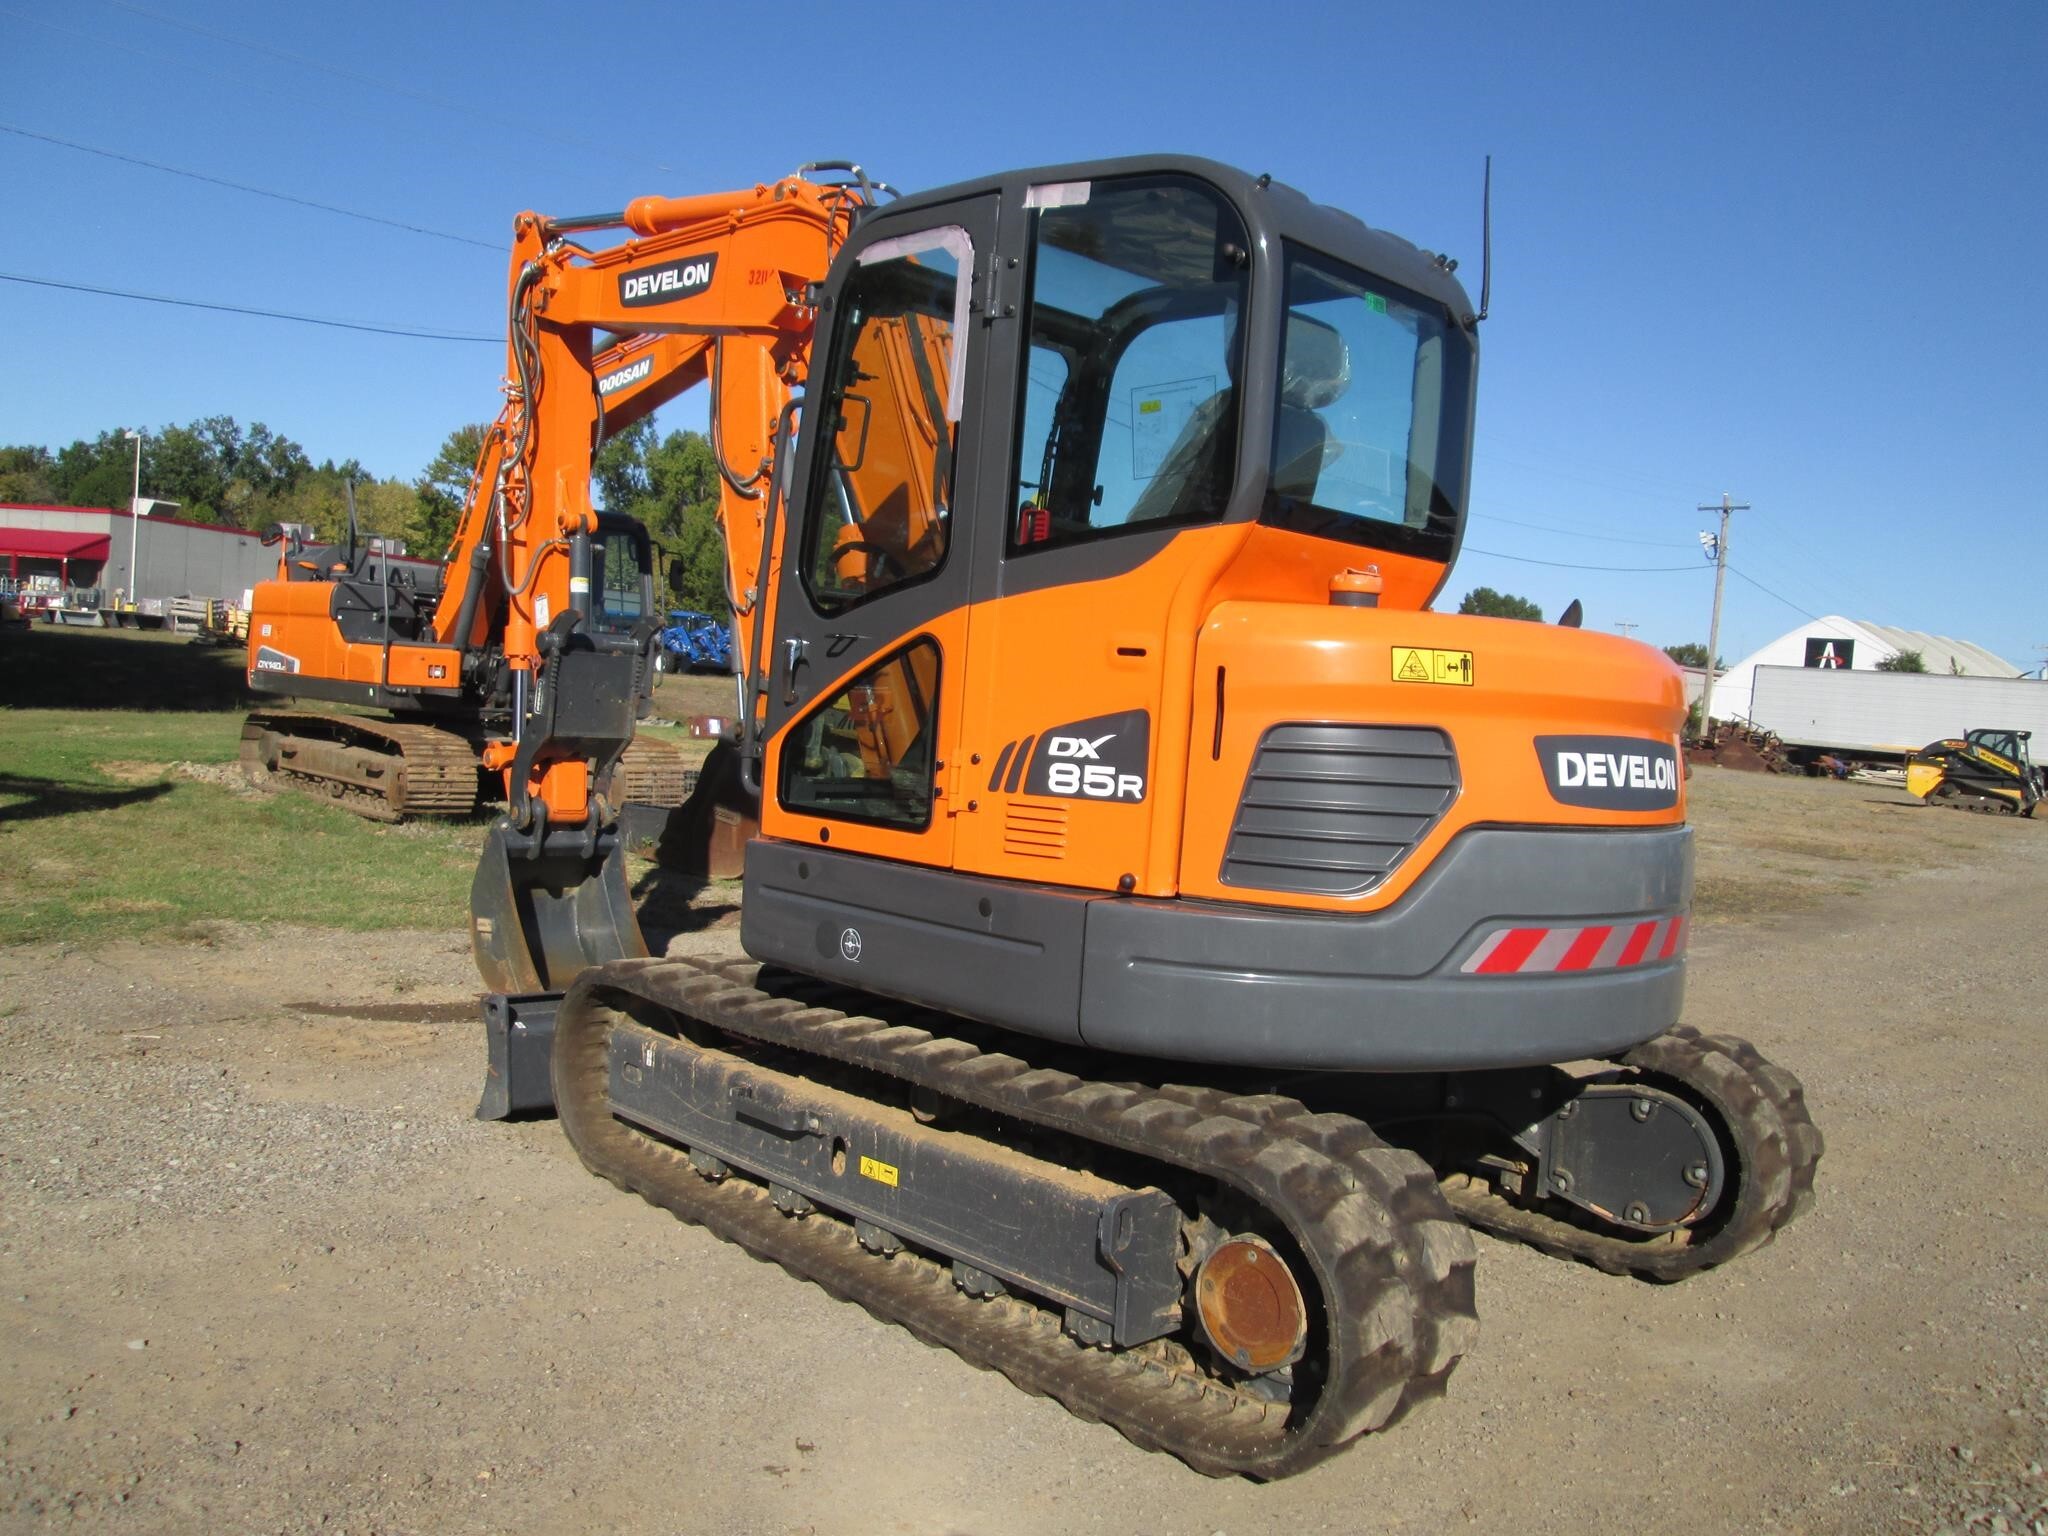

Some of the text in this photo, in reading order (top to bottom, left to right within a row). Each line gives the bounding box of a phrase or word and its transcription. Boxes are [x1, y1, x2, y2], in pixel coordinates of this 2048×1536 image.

[624, 262, 710, 299] DEVELON
[599, 359, 650, 394] DOOSAN
[1048, 734, 1117, 760] DX
[1048, 762, 1143, 799] 85R
[1557, 752, 1676, 790] DEVELON
